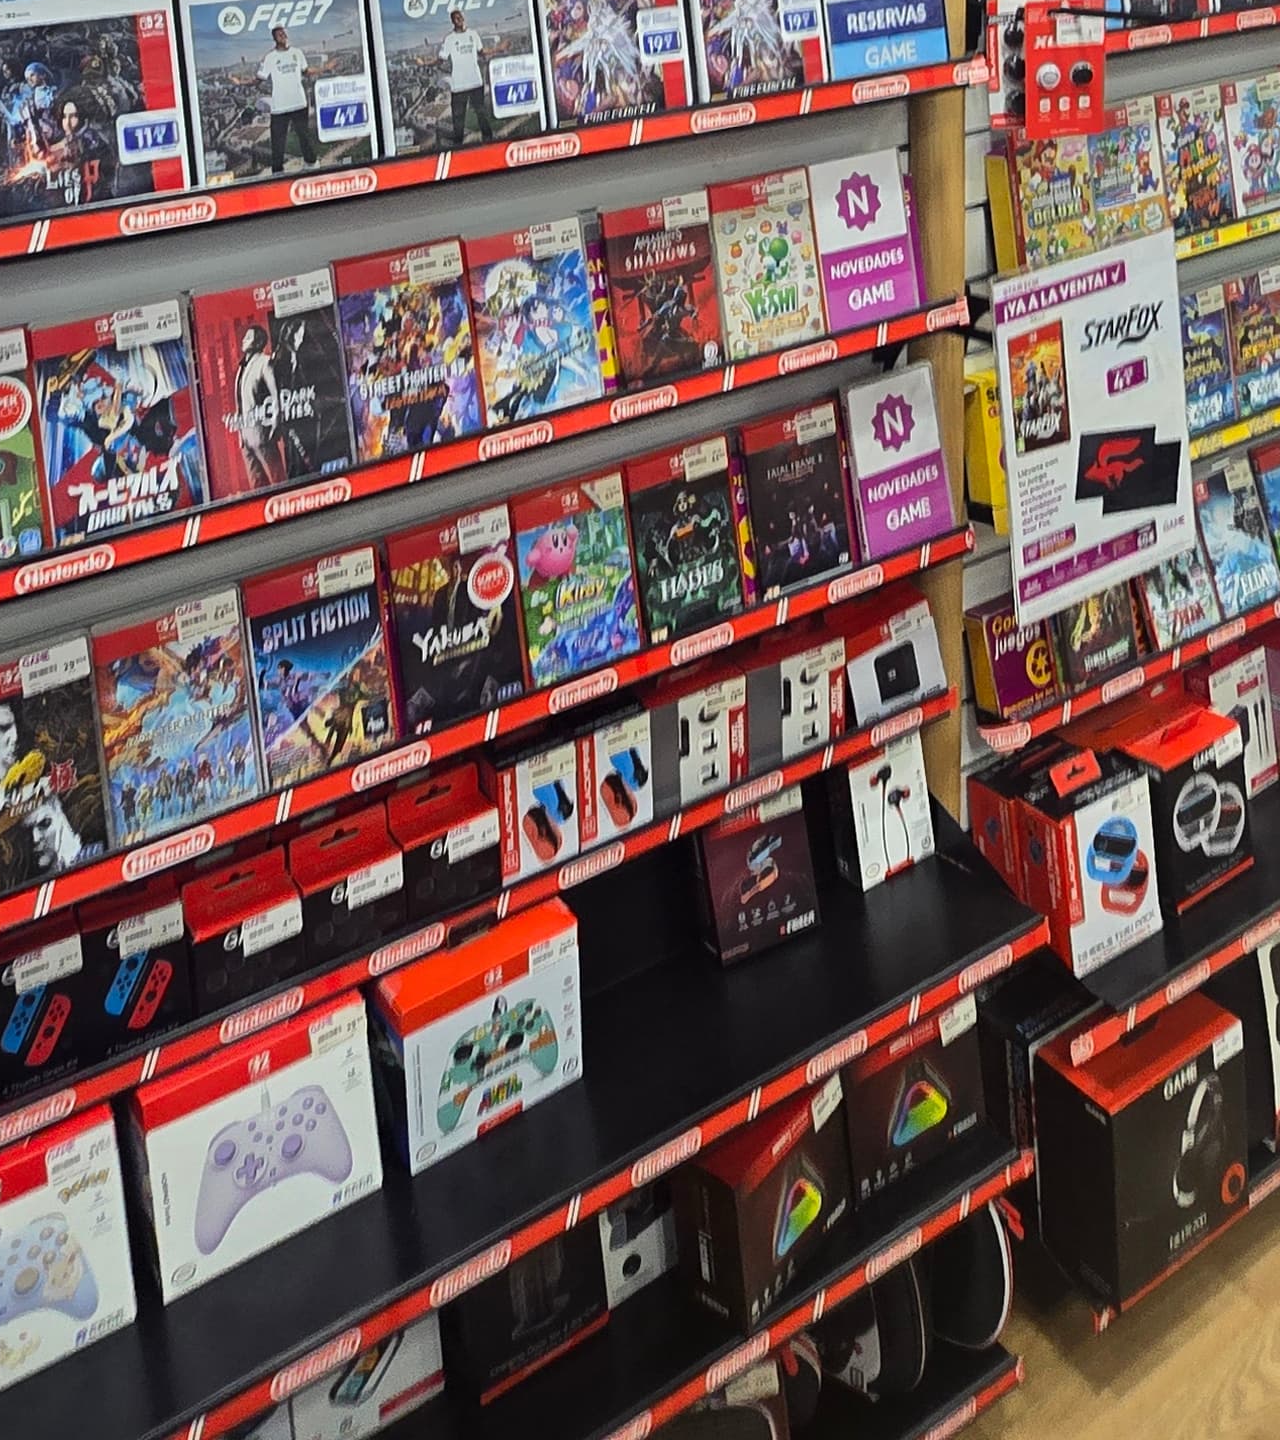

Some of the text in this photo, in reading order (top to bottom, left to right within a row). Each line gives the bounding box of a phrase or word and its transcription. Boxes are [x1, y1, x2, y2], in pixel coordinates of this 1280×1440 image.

[846, 1, 927, 35] RESERVAS
[865, 41, 918, 66] GAME
[847, 187, 869, 216] N
[830, 247, 905, 280] NOVEDADES
[848, 281, 895, 311] GAME
[881, 408, 905, 438] N
[867, 464, 939, 503] NOVEDADES
[885, 497, 932, 532] GAME
[261, 592, 371, 653] SPLIT FICTION
[1163, 1060, 1199, 1103] GAME
